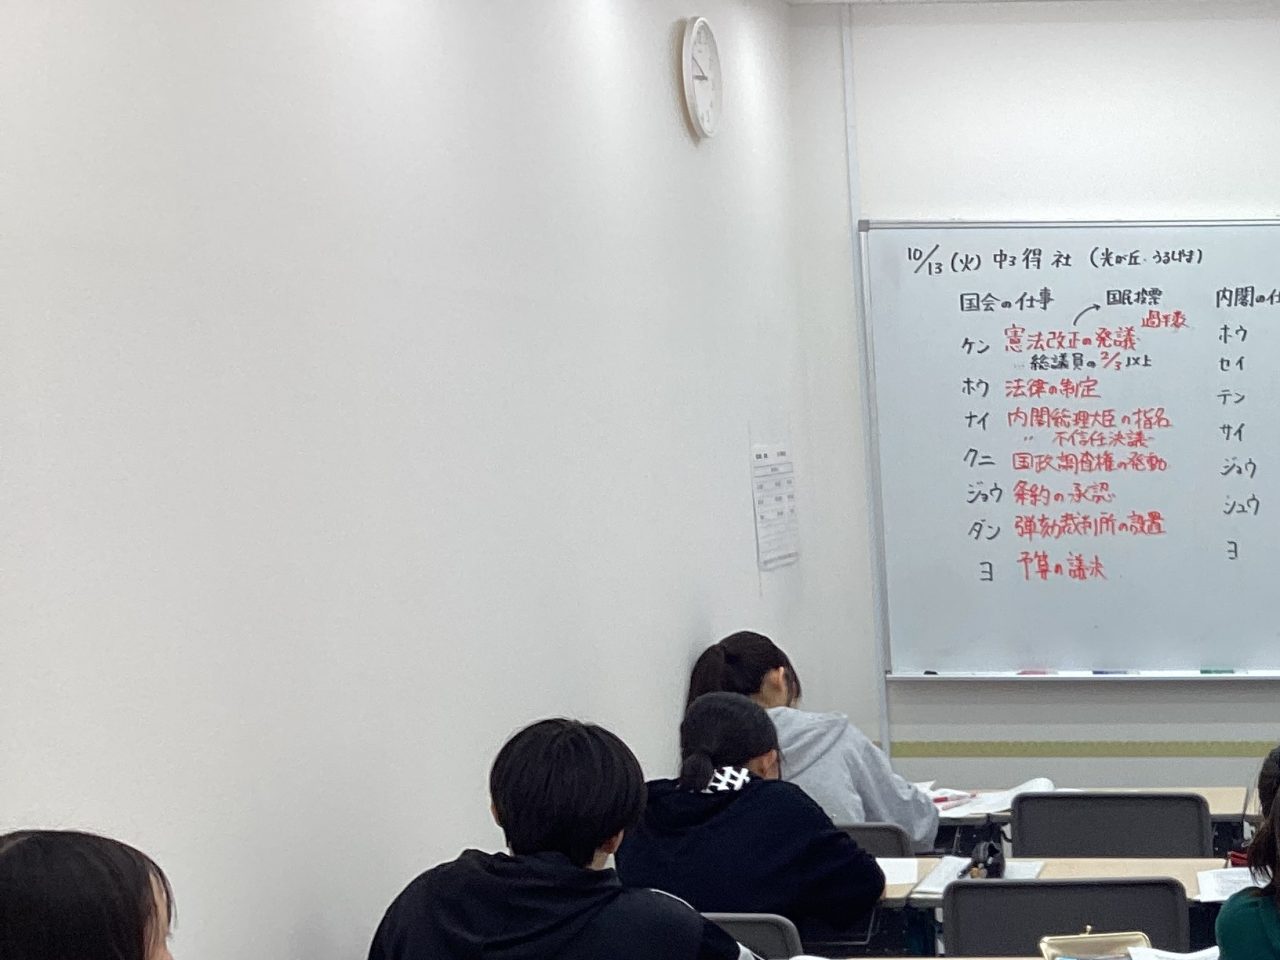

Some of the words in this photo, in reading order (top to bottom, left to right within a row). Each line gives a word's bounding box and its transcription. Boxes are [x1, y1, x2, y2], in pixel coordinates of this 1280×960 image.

[960, 286, 1055, 312] 国会の仕事
[1106, 287, 1163, 306] 国民投票
[1219, 324, 1247, 344] ホウ
[962, 337, 990, 354] ケン
[1219, 356, 1245, 371] セイ
[962, 377, 990, 398] ホウ
[1005, 376, 1101, 398] 法律の制定
[1217, 388, 1245, 405] テン
[965, 411, 989, 431] ナイ
[1219, 423, 1245, 441] サイ
[963, 448, 996, 468] クニ
[1220, 456, 1257, 479] ジョウ
[967, 481, 1003, 503] ジョウ
[1223, 494, 1260, 516] シュウ
[967, 519, 1001, 541] ダン
[1016, 551, 1107, 580] 予算の議決
